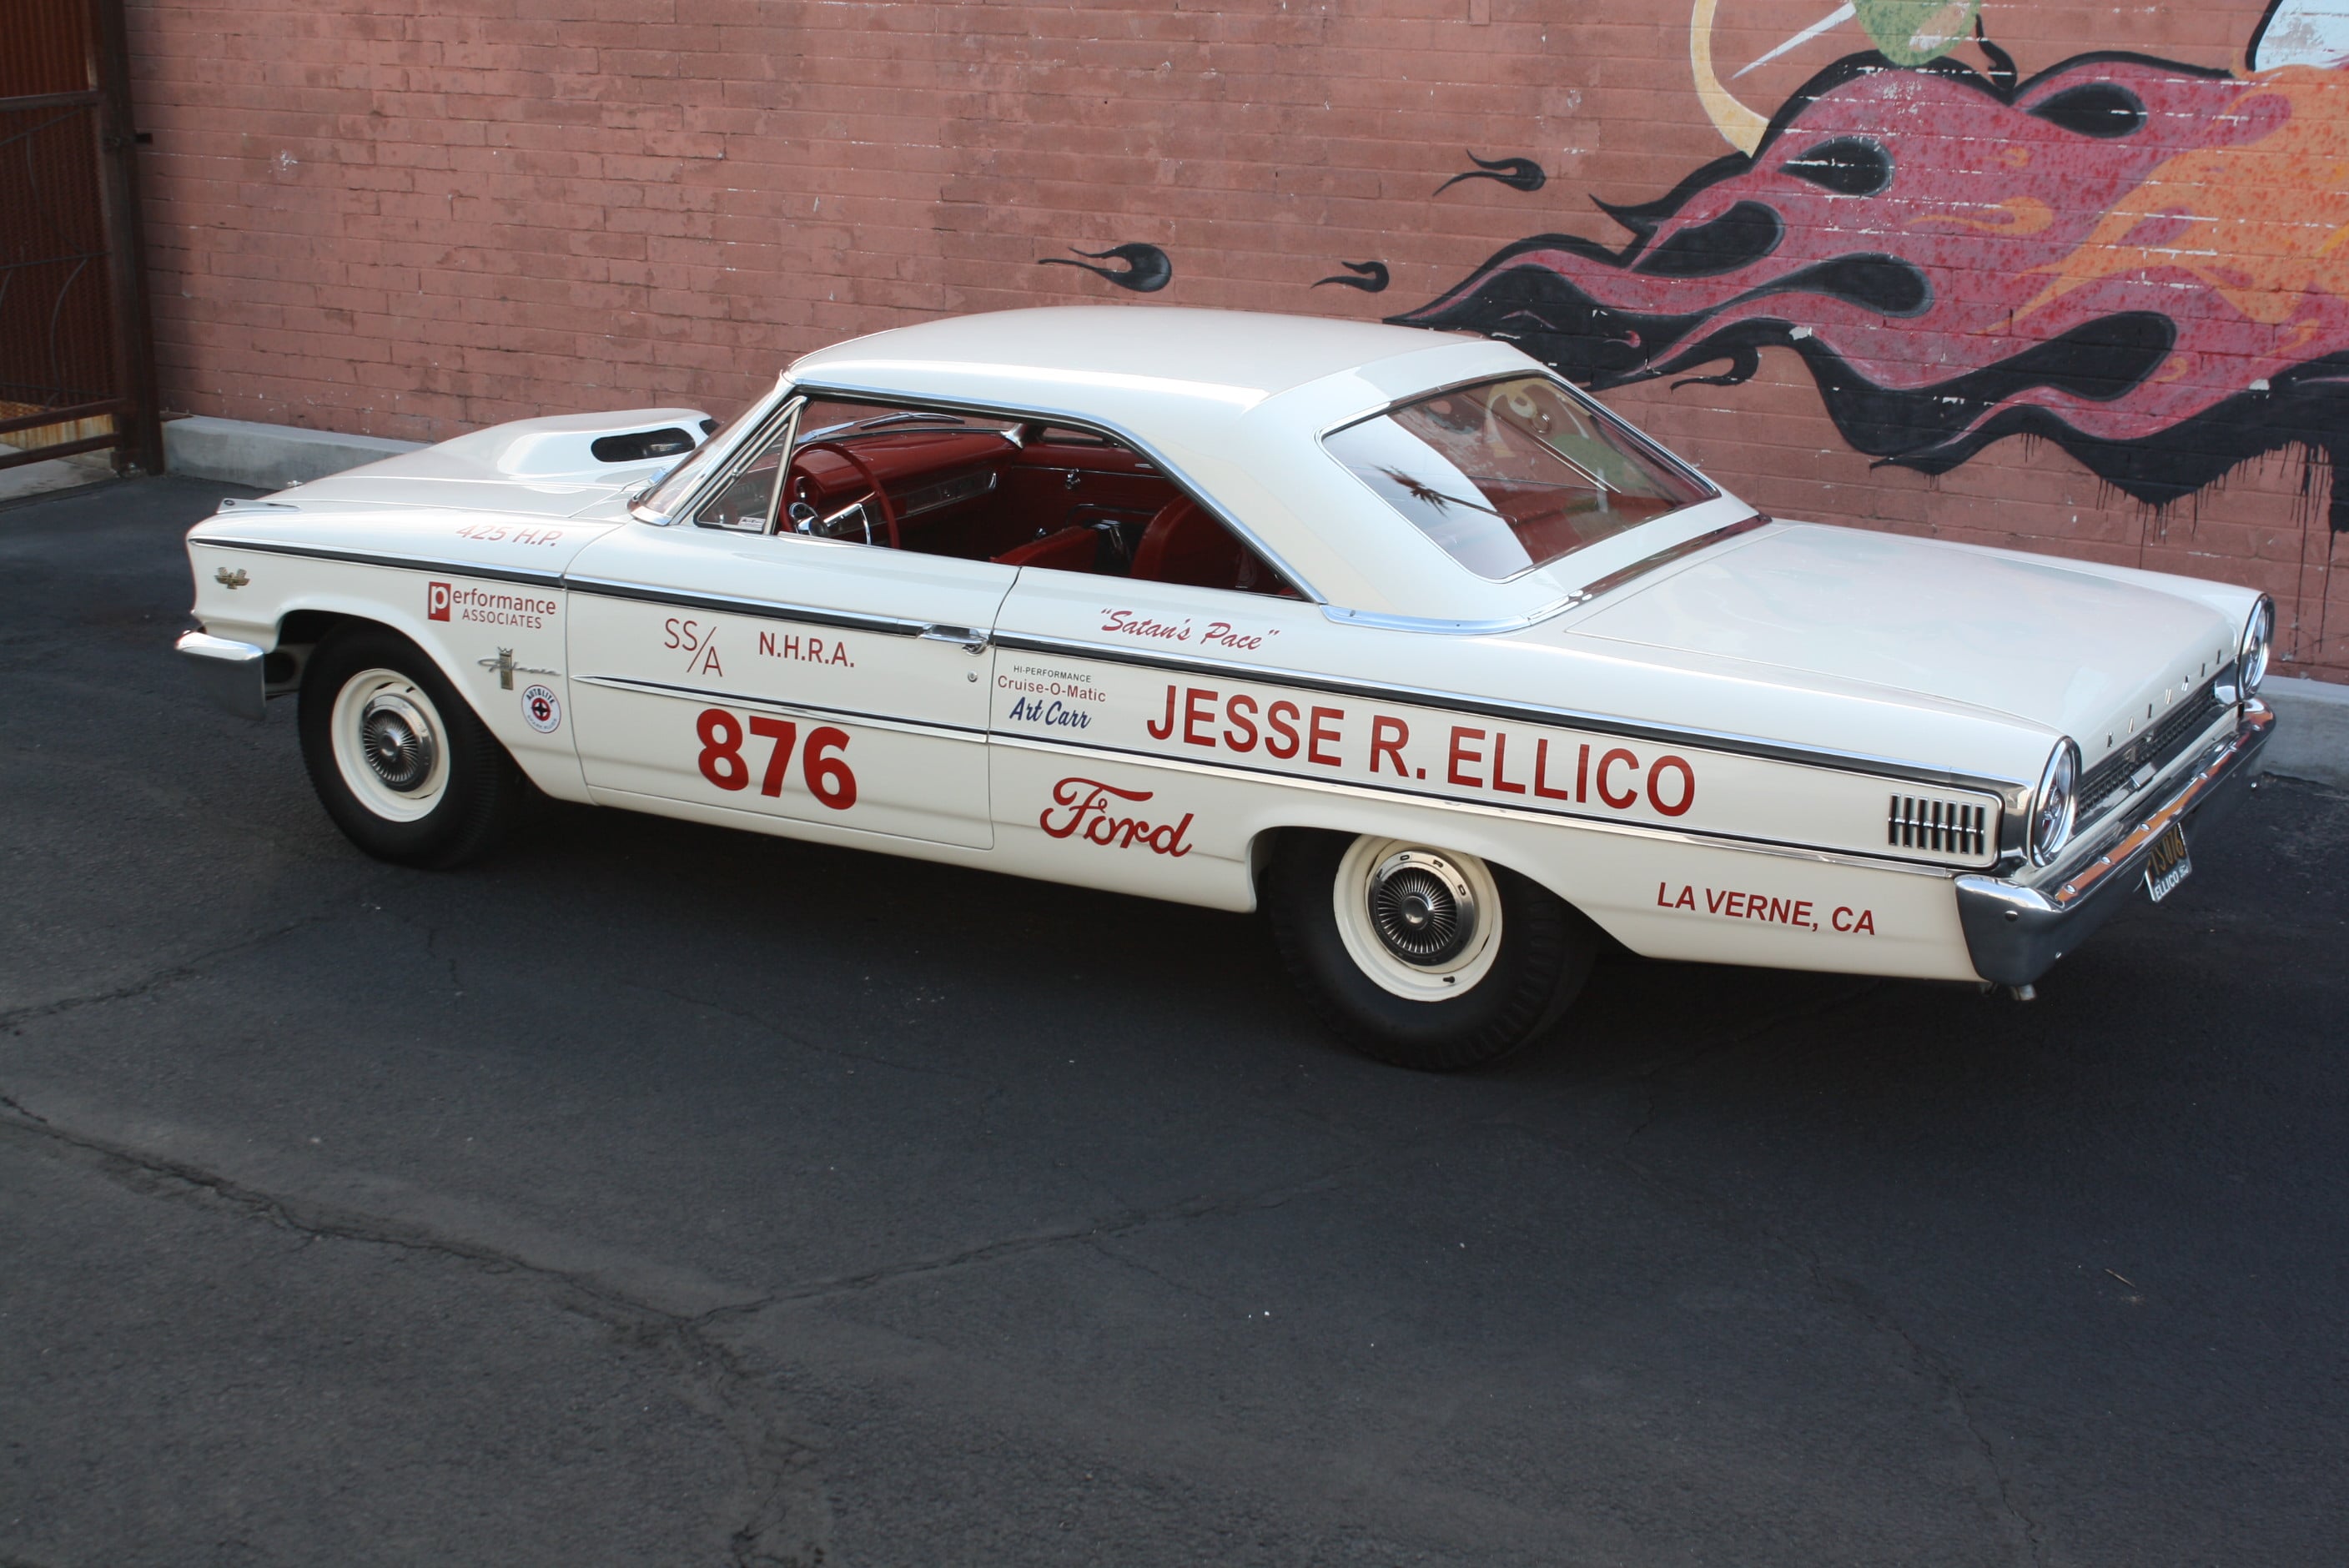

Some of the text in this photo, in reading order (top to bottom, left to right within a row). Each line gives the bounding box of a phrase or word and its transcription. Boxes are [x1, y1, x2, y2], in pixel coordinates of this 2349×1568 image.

[456, 523, 563, 547] 425 H.P.
[429, 583, 556, 616] performance
[462, 608, 542, 629] ASSOCIATES
[759, 631, 855, 668] N.H.R.A.
[998, 675, 1106, 702] Cruise-O-Matic
[1014, 665, 1092, 683] HI-PERFORMANCE
[1009, 696, 1092, 729] Art Carr
[696, 708, 858, 811] 876
[1147, 685, 1696, 817] JESSE R. ELLICO
[1039, 777, 1195, 857] Ford
[2155, 871, 2180, 900] ELLICO
[1657, 882, 1875, 936] LA VERNE, CA
